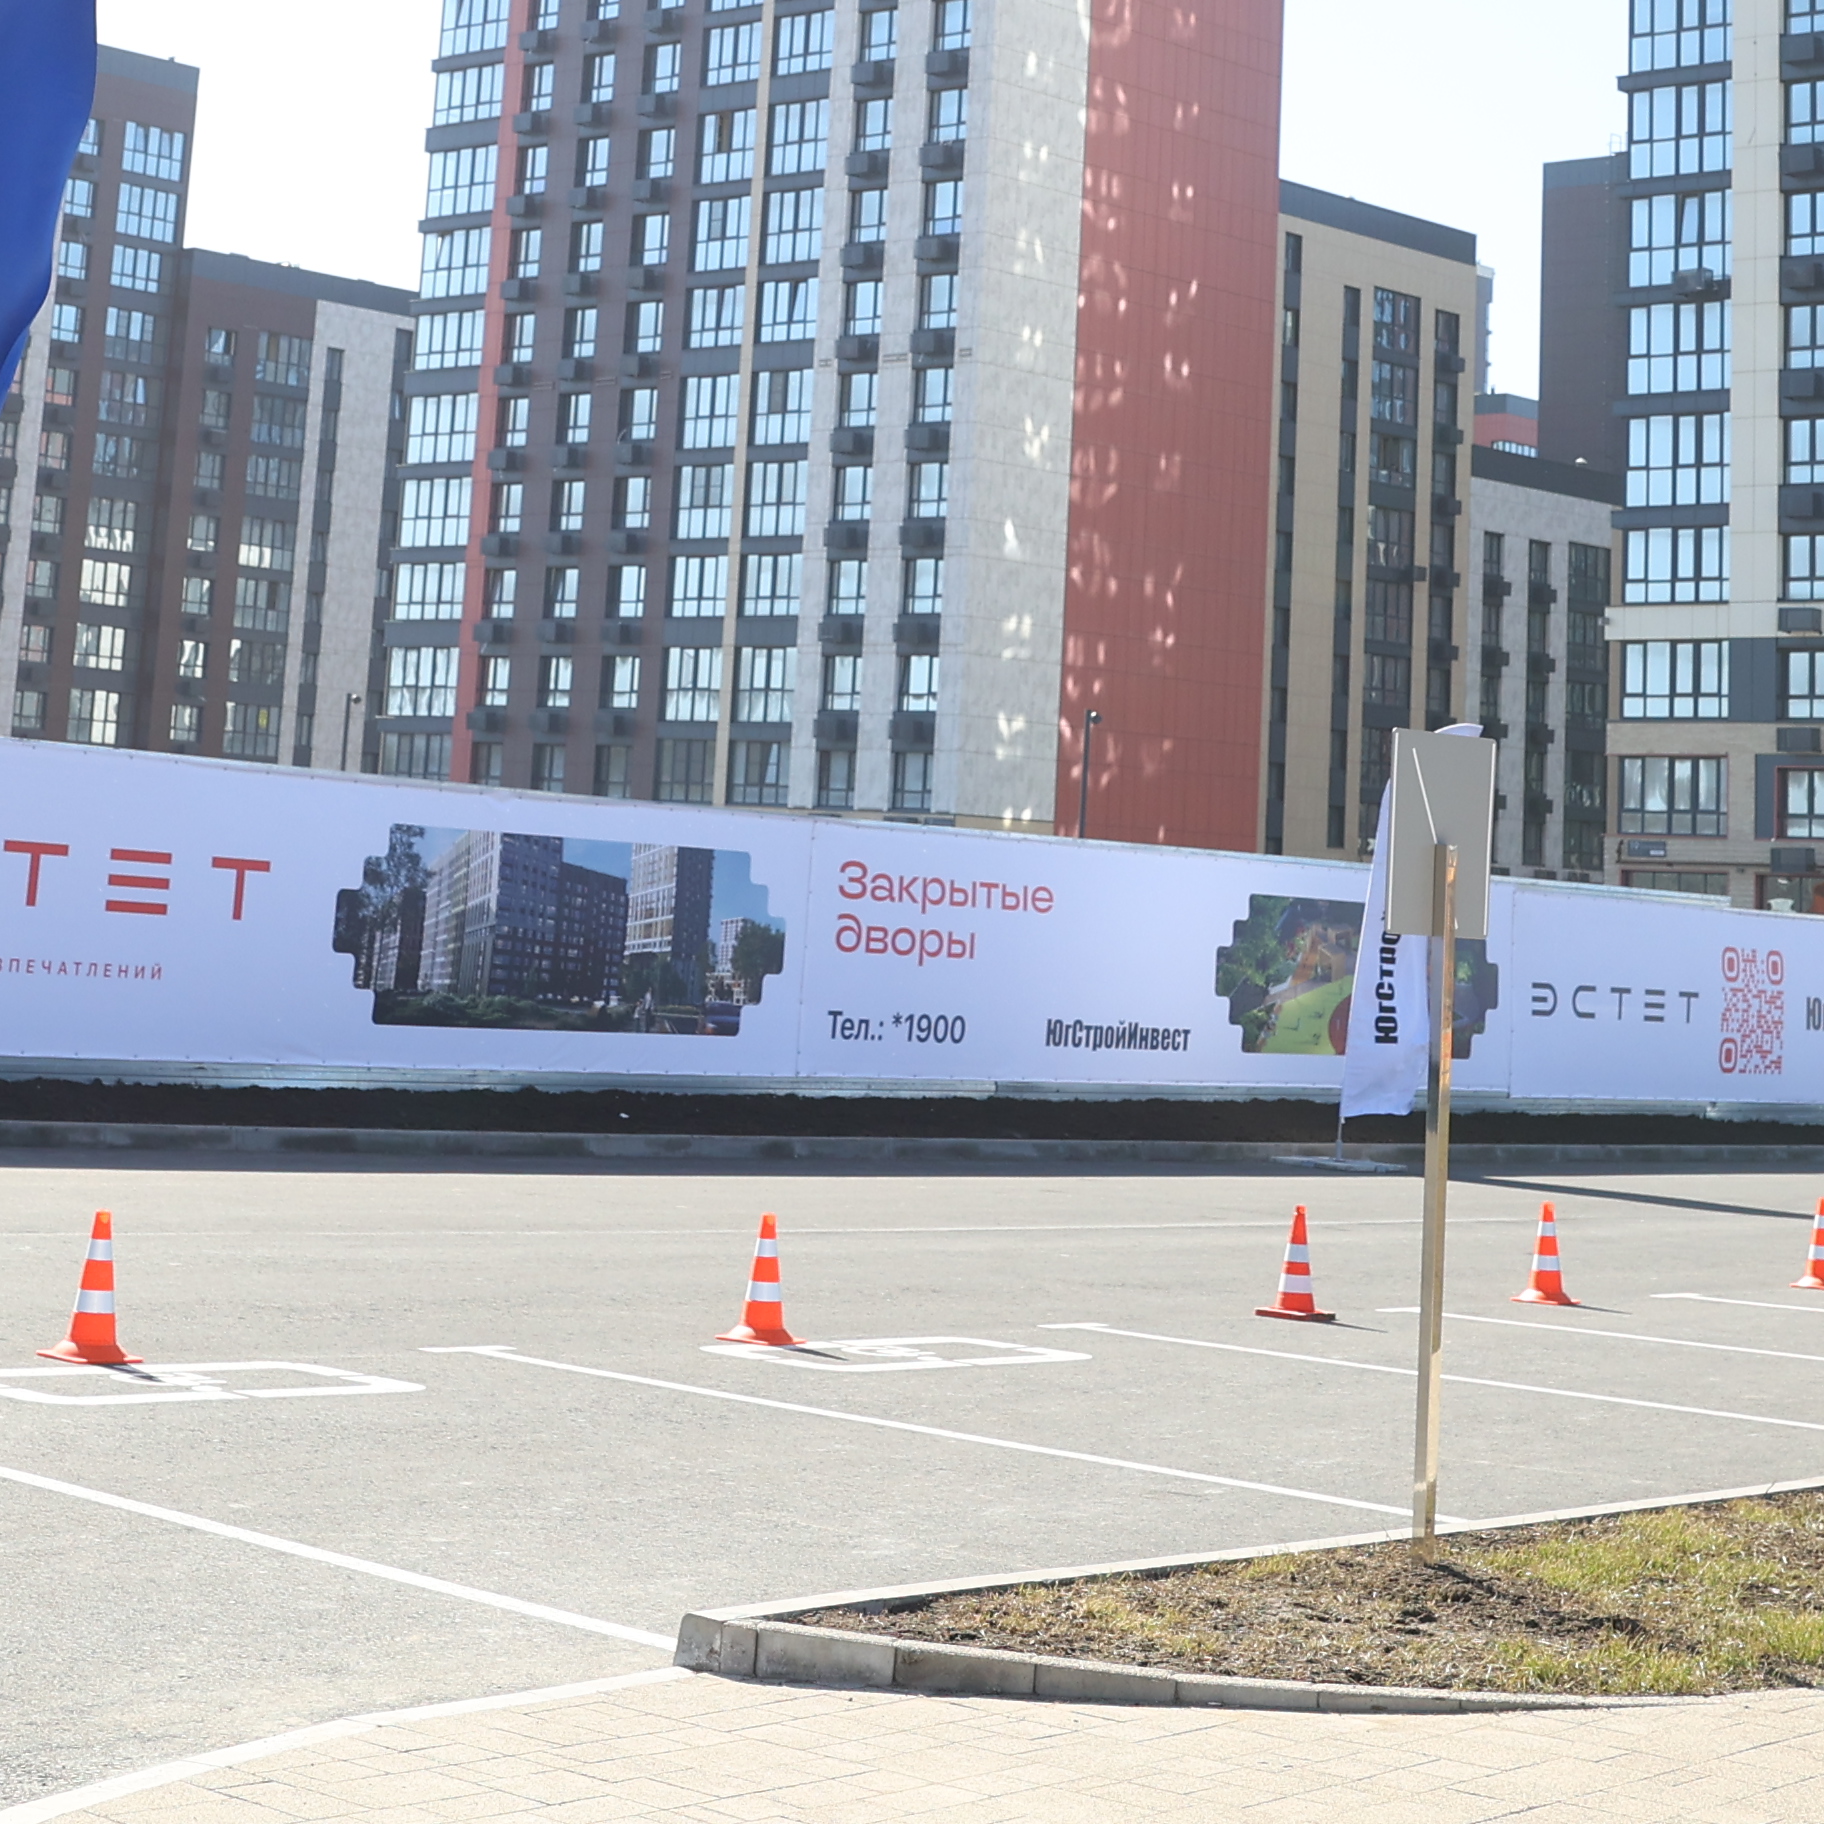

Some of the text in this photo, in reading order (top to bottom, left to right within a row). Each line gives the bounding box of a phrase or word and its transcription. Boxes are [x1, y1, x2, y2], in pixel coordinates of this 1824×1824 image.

[837, 859, 1054, 914] Закрытые
[835, 913, 976, 966] дворы
[1374, 911, 1402, 1044] ЮгСтро
[827, 1010, 883, 1042] Тел.:
[1531, 981, 1700, 1024] ЭСТЕТ
[1045, 1018, 1191, 1053] ЮгСтройИнвест
